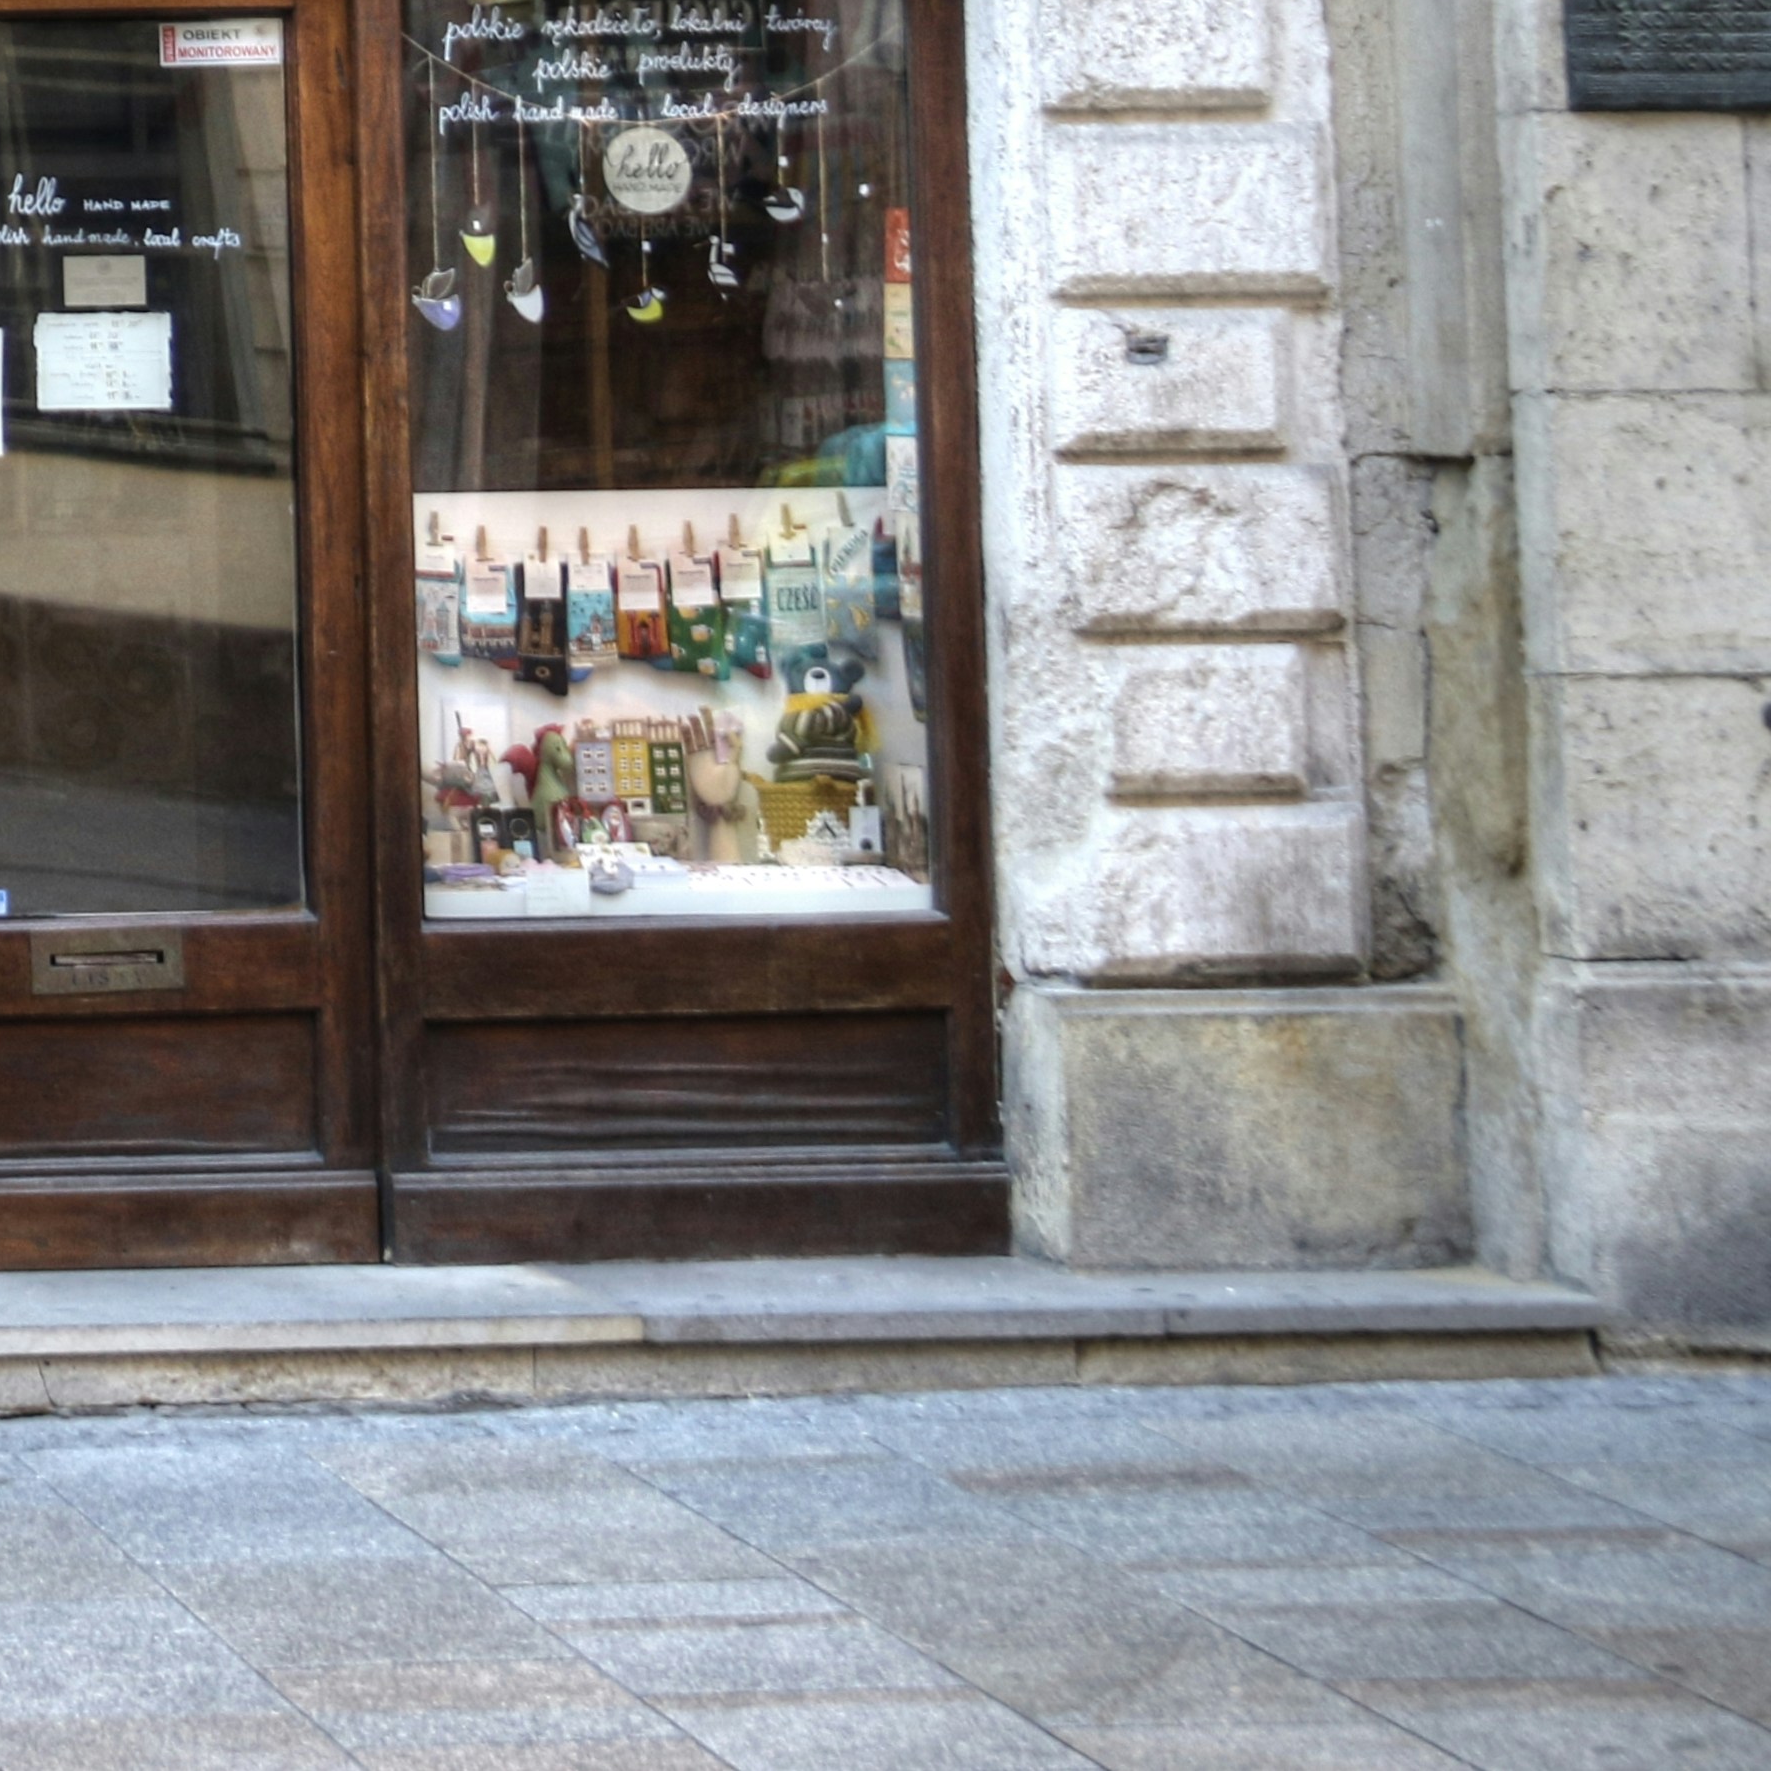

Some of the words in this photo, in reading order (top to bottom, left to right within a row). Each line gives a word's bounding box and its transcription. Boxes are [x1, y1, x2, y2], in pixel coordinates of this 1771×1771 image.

[178, 45, 276, 58] MONITOROWANY
[182, 29, 241, 41] OBIEKT
[443, 4, 524, 61] polskie
[532, 48, 612, 94] polskie
[637, 41, 742, 93] produkty
[438, 92, 499, 136] polish
[661, 93, 717, 117] local
[737, 92, 829, 129] designers
[609, 141, 685, 179] hello
[8, 173, 65, 214] hello
[83, 199, 124, 211] HAND
[130, 199, 171, 211] MADE
[143, 227, 181, 247] local
[192, 227, 241, 260] crafts
